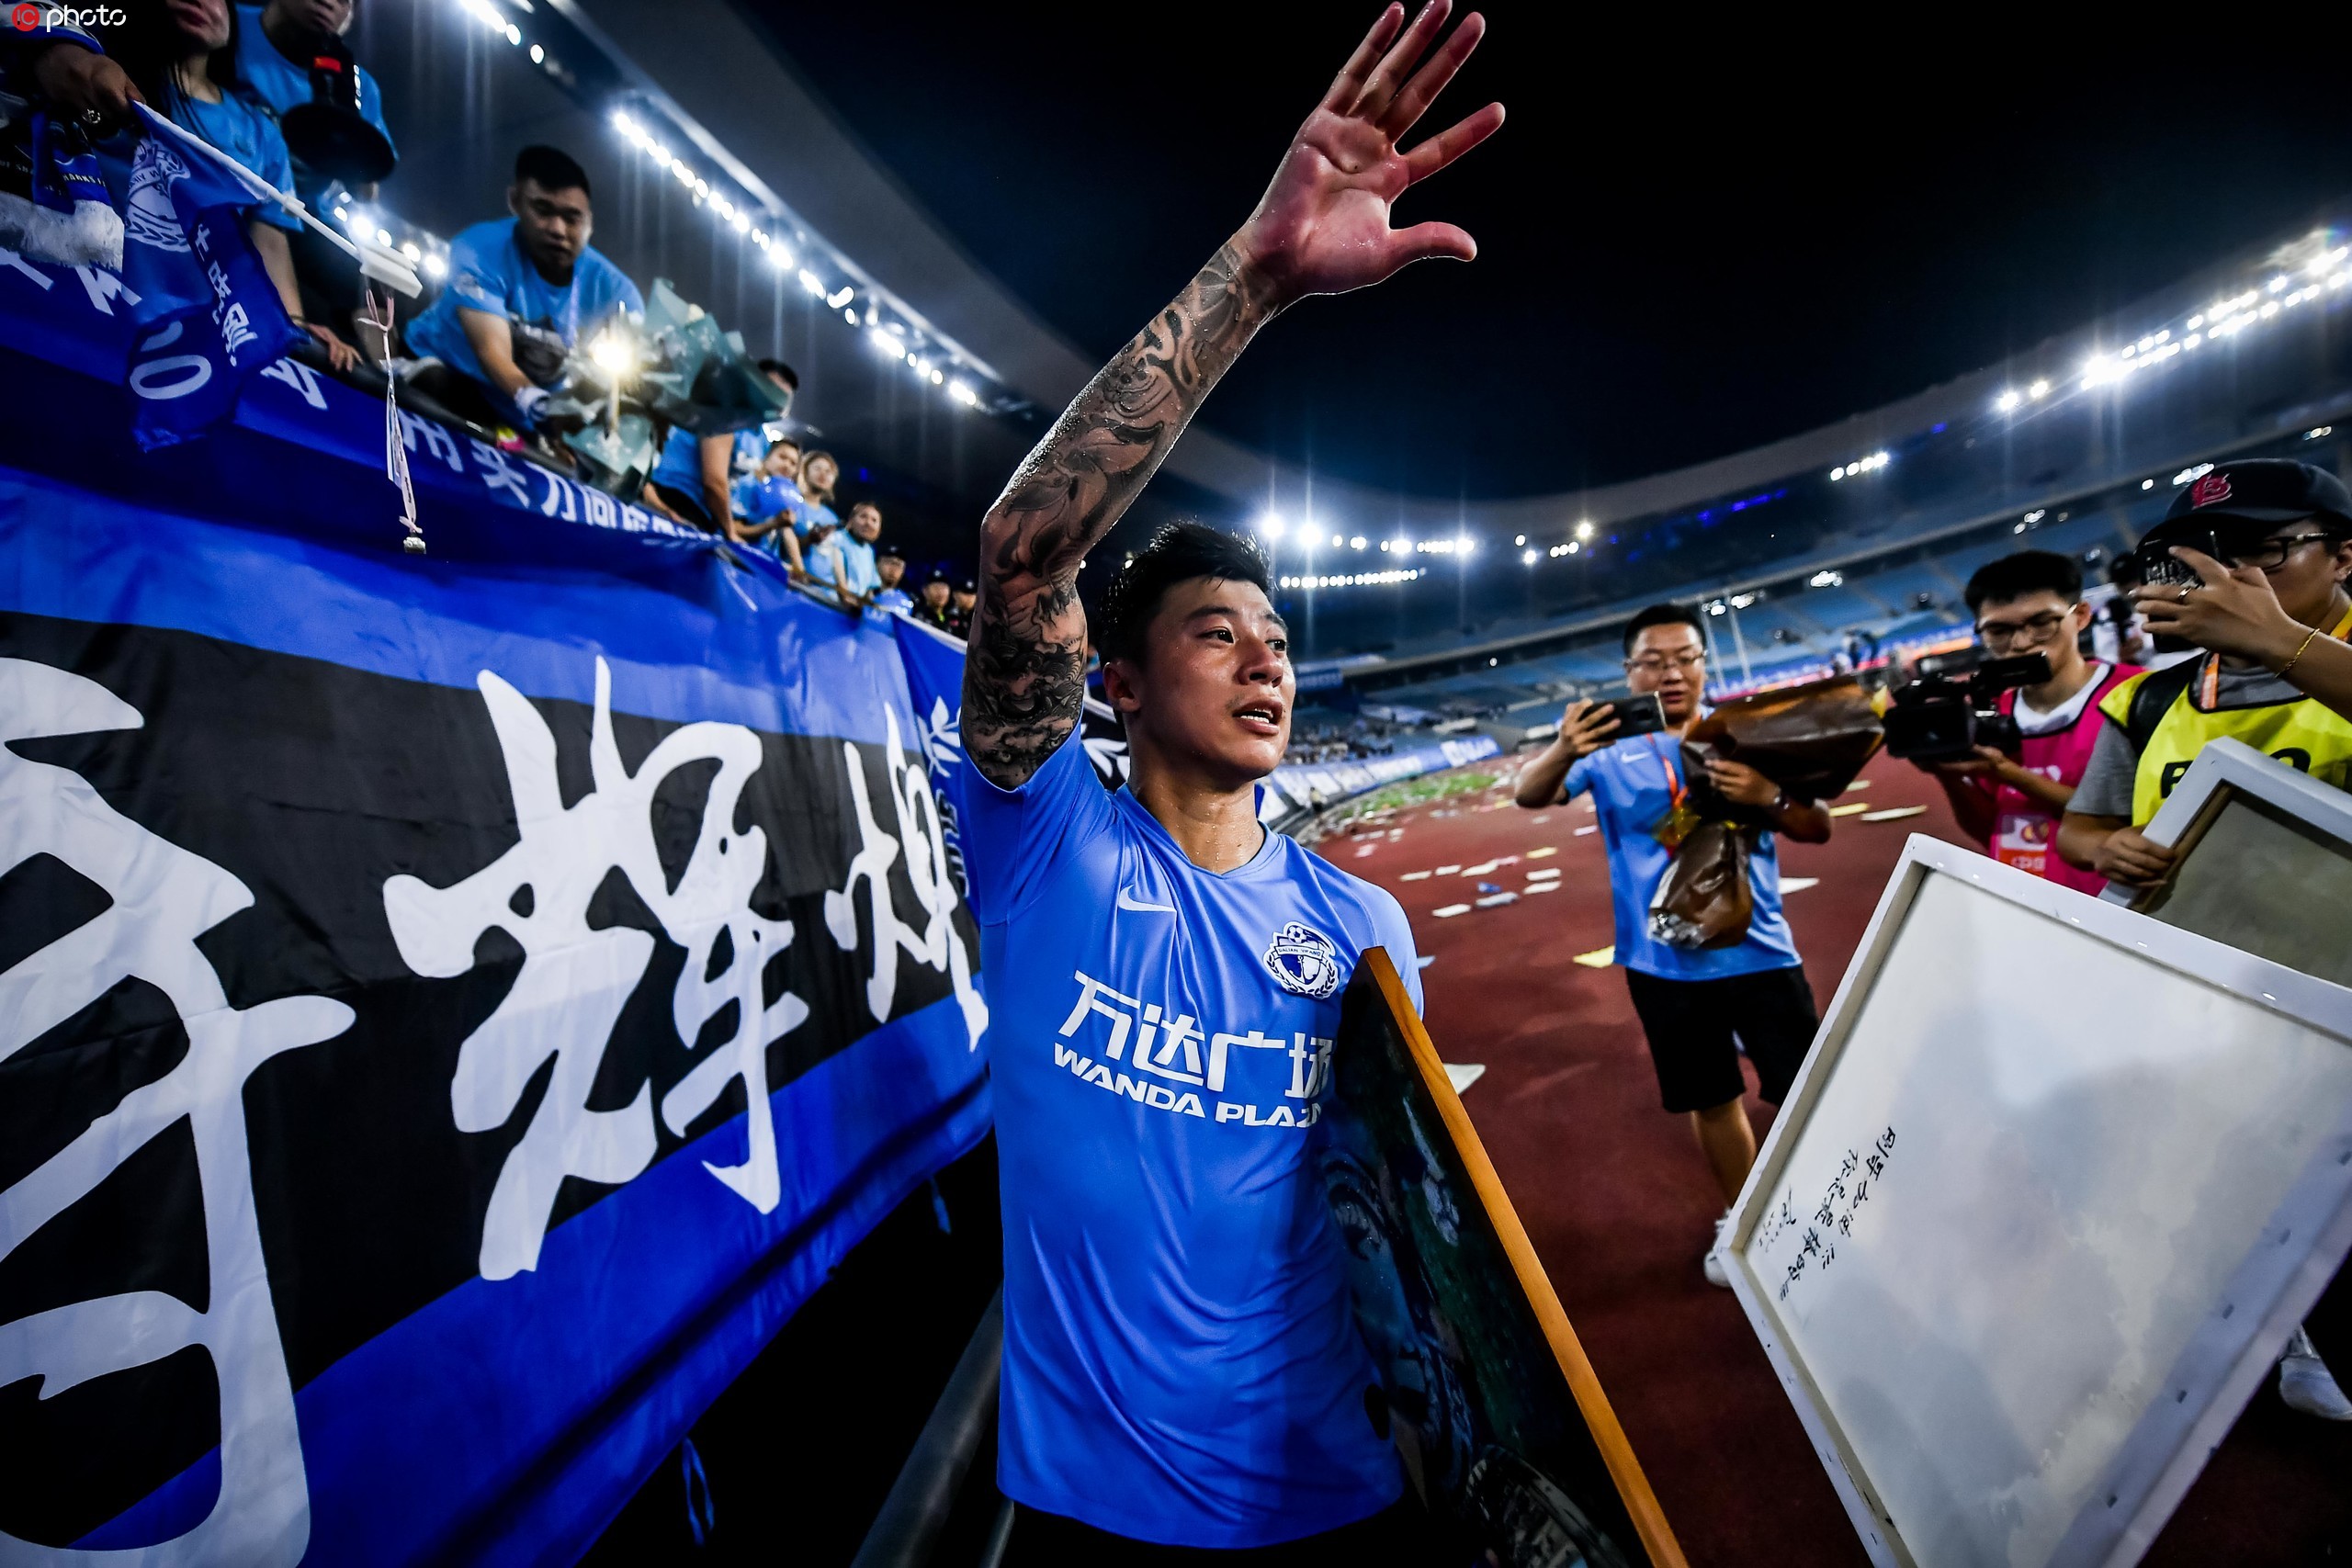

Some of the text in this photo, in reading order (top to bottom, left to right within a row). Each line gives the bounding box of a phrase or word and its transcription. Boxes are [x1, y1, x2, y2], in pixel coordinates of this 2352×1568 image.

[1054, 1042, 1206, 1119] WANDA
[1057, 969, 1334, 1100] 万达广场
